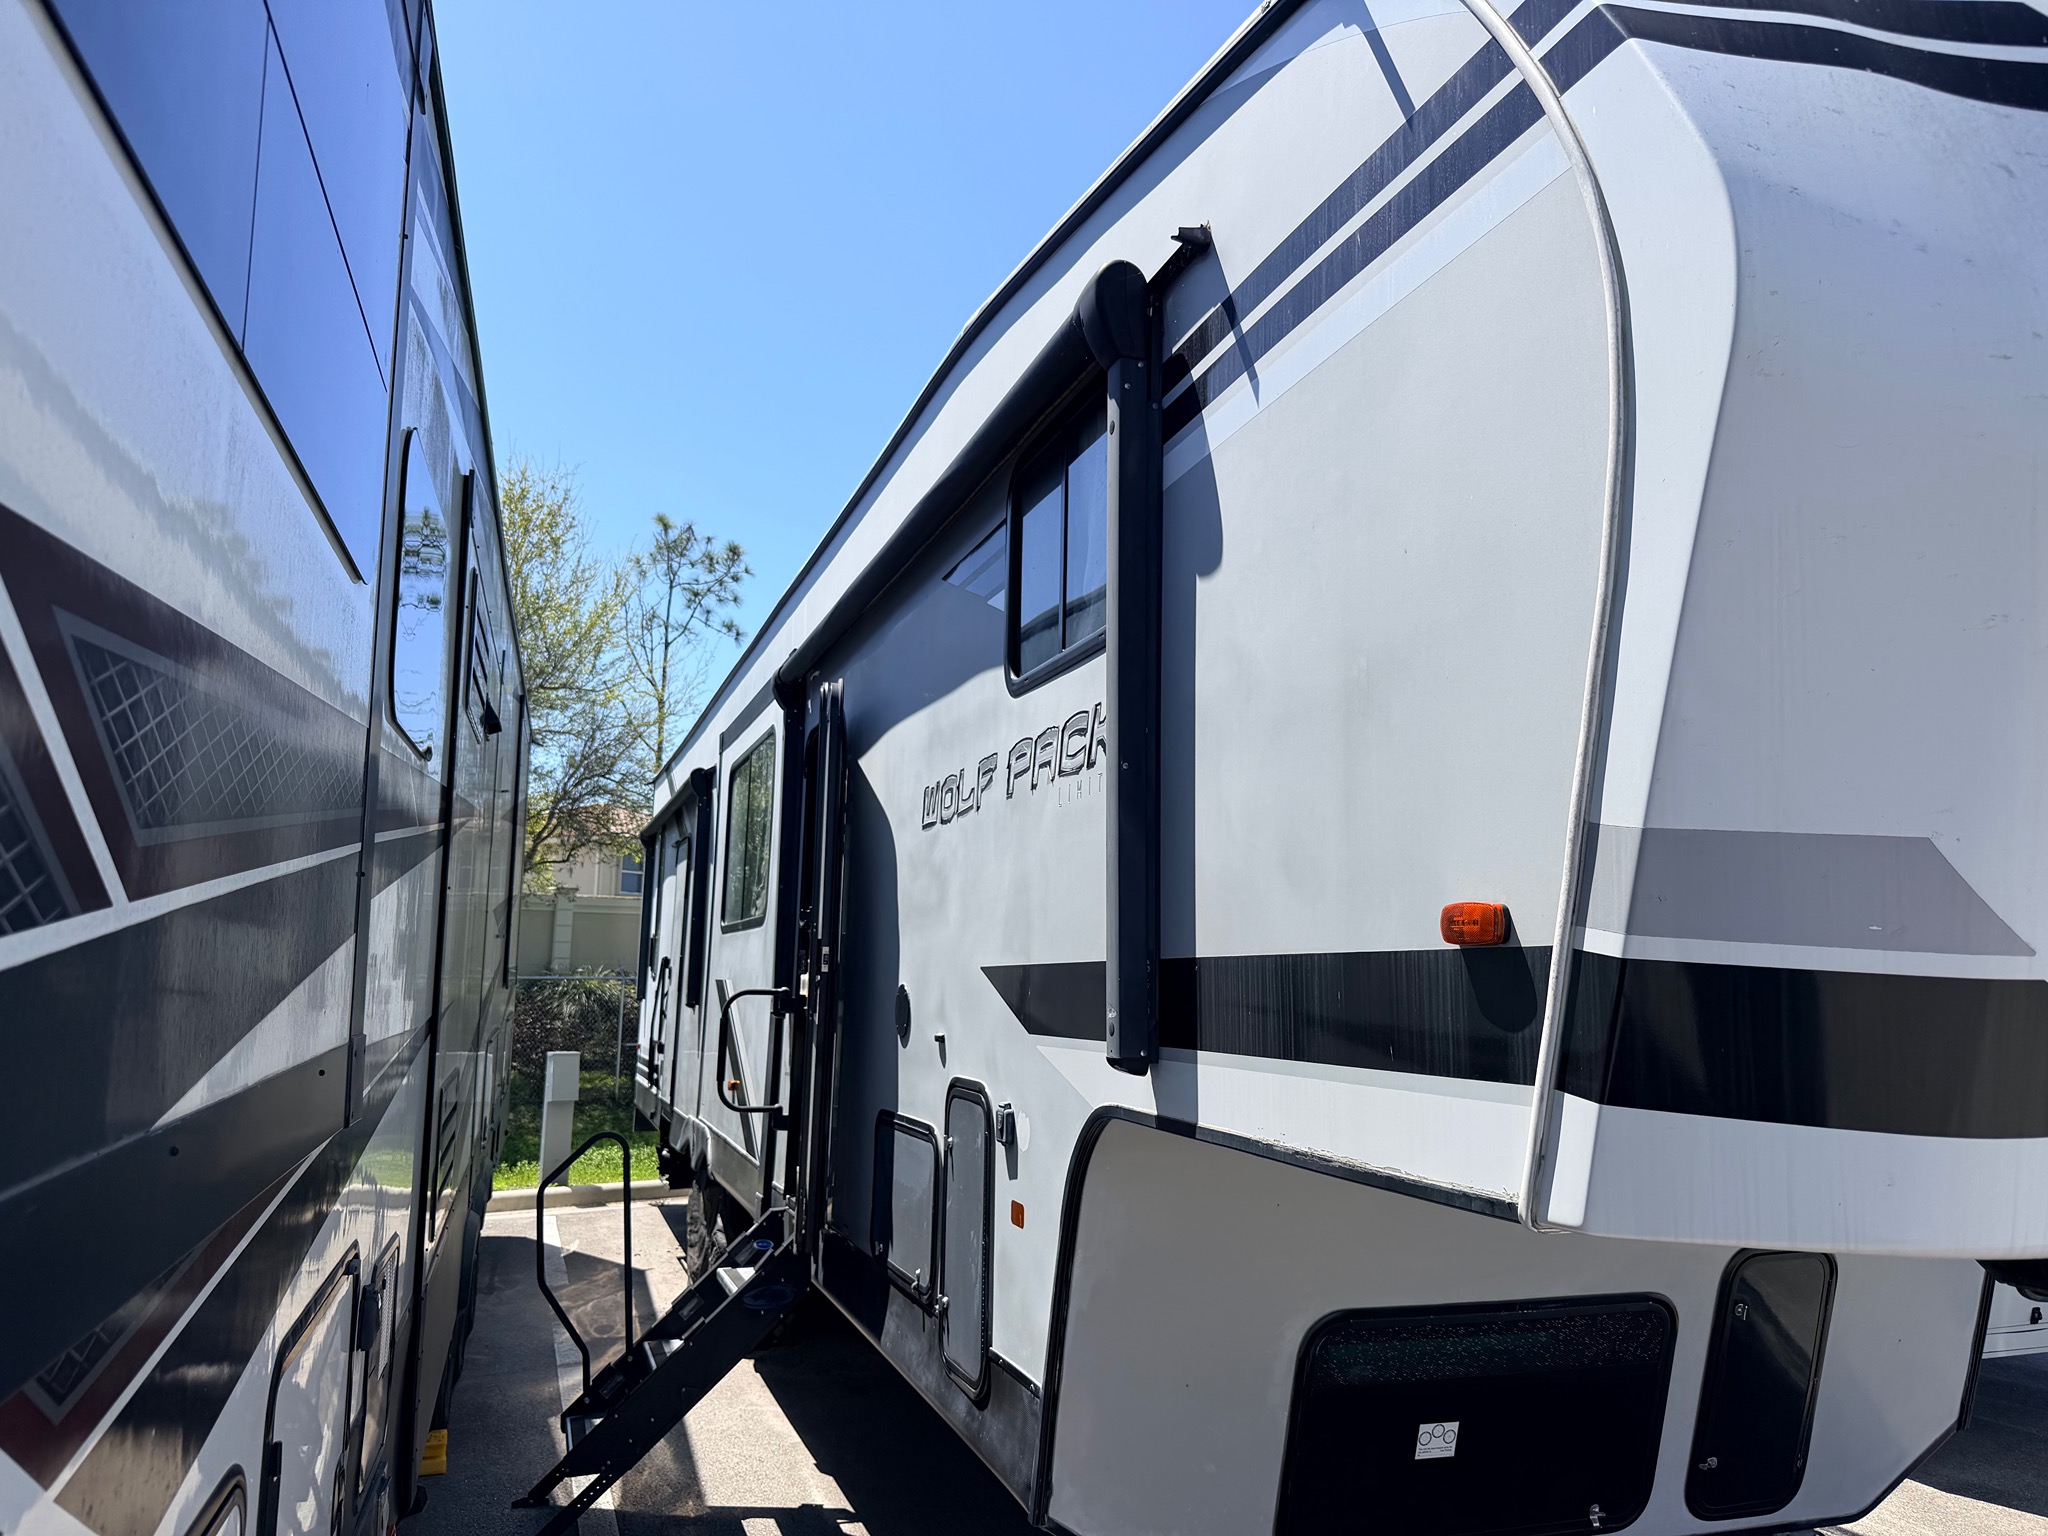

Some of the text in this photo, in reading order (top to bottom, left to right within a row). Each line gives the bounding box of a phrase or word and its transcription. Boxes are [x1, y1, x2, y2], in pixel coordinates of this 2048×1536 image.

[922, 702, 1106, 831] WOLF PACK
[1058, 772, 1103, 808] LIMIT
